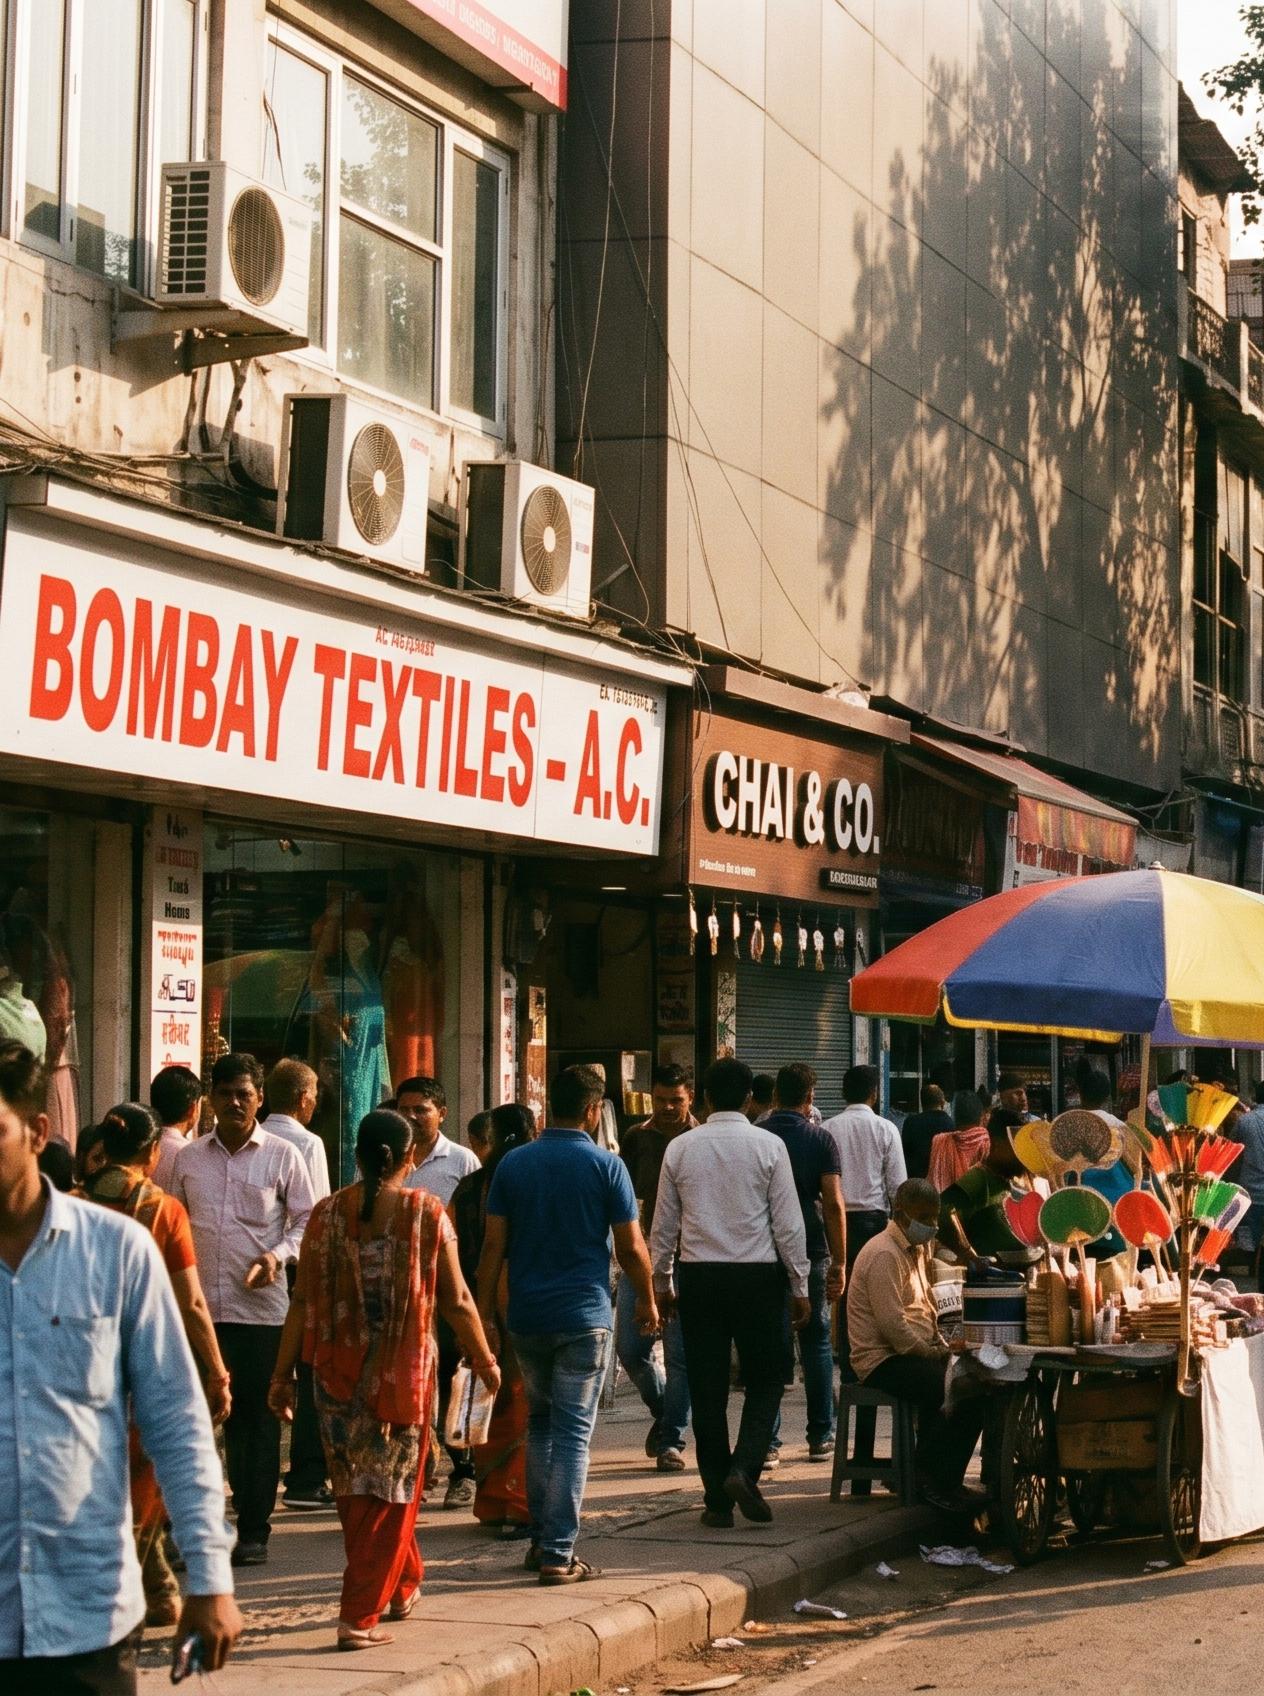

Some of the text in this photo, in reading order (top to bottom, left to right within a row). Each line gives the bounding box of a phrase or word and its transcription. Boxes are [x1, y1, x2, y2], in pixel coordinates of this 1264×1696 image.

[29, 574, 650, 826] BOMBAY TEXTILES - A.C.
[714, 751, 880, 854] CHAI & CO.
